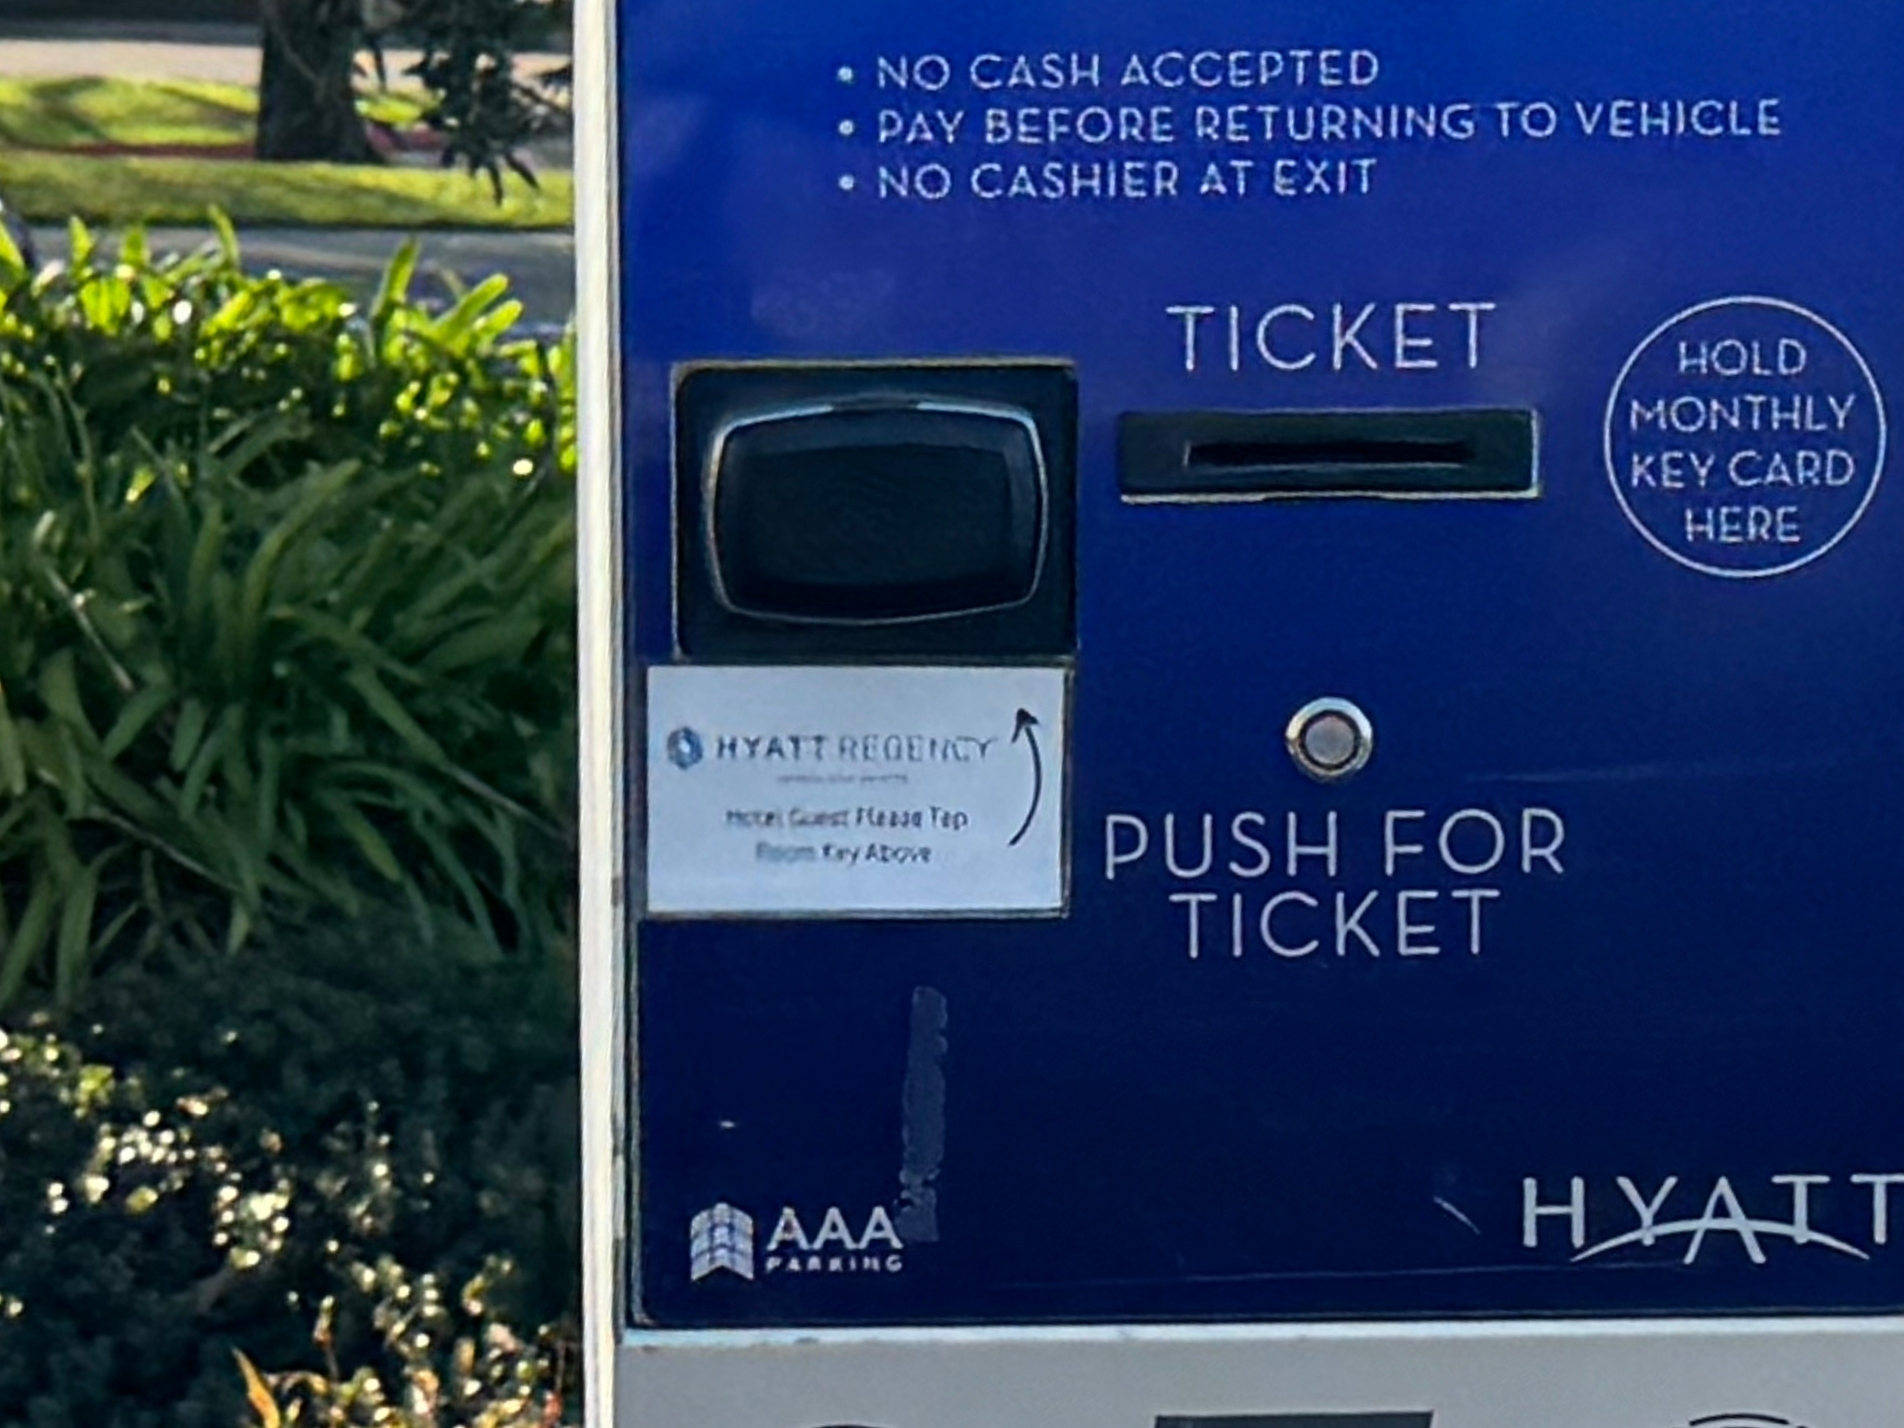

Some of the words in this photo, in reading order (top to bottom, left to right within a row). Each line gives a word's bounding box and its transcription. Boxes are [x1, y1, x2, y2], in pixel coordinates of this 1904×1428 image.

[876, 53, 951, 92] NO
[968, 51, 1101, 91] CASH
[1119, 48, 1380, 89] ACCEPTED
[878, 108, 965, 145] PAY
[984, 104, 1176, 145] BEFORE
[1195, 102, 1476, 143] RETURNING
[1494, 100, 1559, 139] TO
[1574, 97, 1782, 139] VEHICLE
[876, 162, 952, 201] NO
[969, 159, 1180, 200] CASHIER
[1198, 158, 1255, 197] AT
[1272, 157, 1378, 197] EXIT
[1164, 301, 1497, 372] TICKET
[1678, 336, 1808, 377] HOLD
[1629, 393, 1857, 434] MONTHLY
[1630, 449, 1716, 490] KEY
[1727, 447, 1856, 488] CARD
[1684, 504, 1802, 544] HERE
[716, 733, 827, 761] HYATT
[837, 733, 997, 763] REGENCY
[854, 805, 923, 829] Please
[928, 804, 970, 832] Tap
[821, 841, 860, 869] Key
[864, 842, 932, 865] Above
[1104, 809, 1338, 881] PUSH
[1383, 806, 1566, 877] FOR
[1167, 887, 1502, 960] TICKET
[765, 1205, 905, 1253] AAA
[764, 1253, 903, 1273] PARKING
